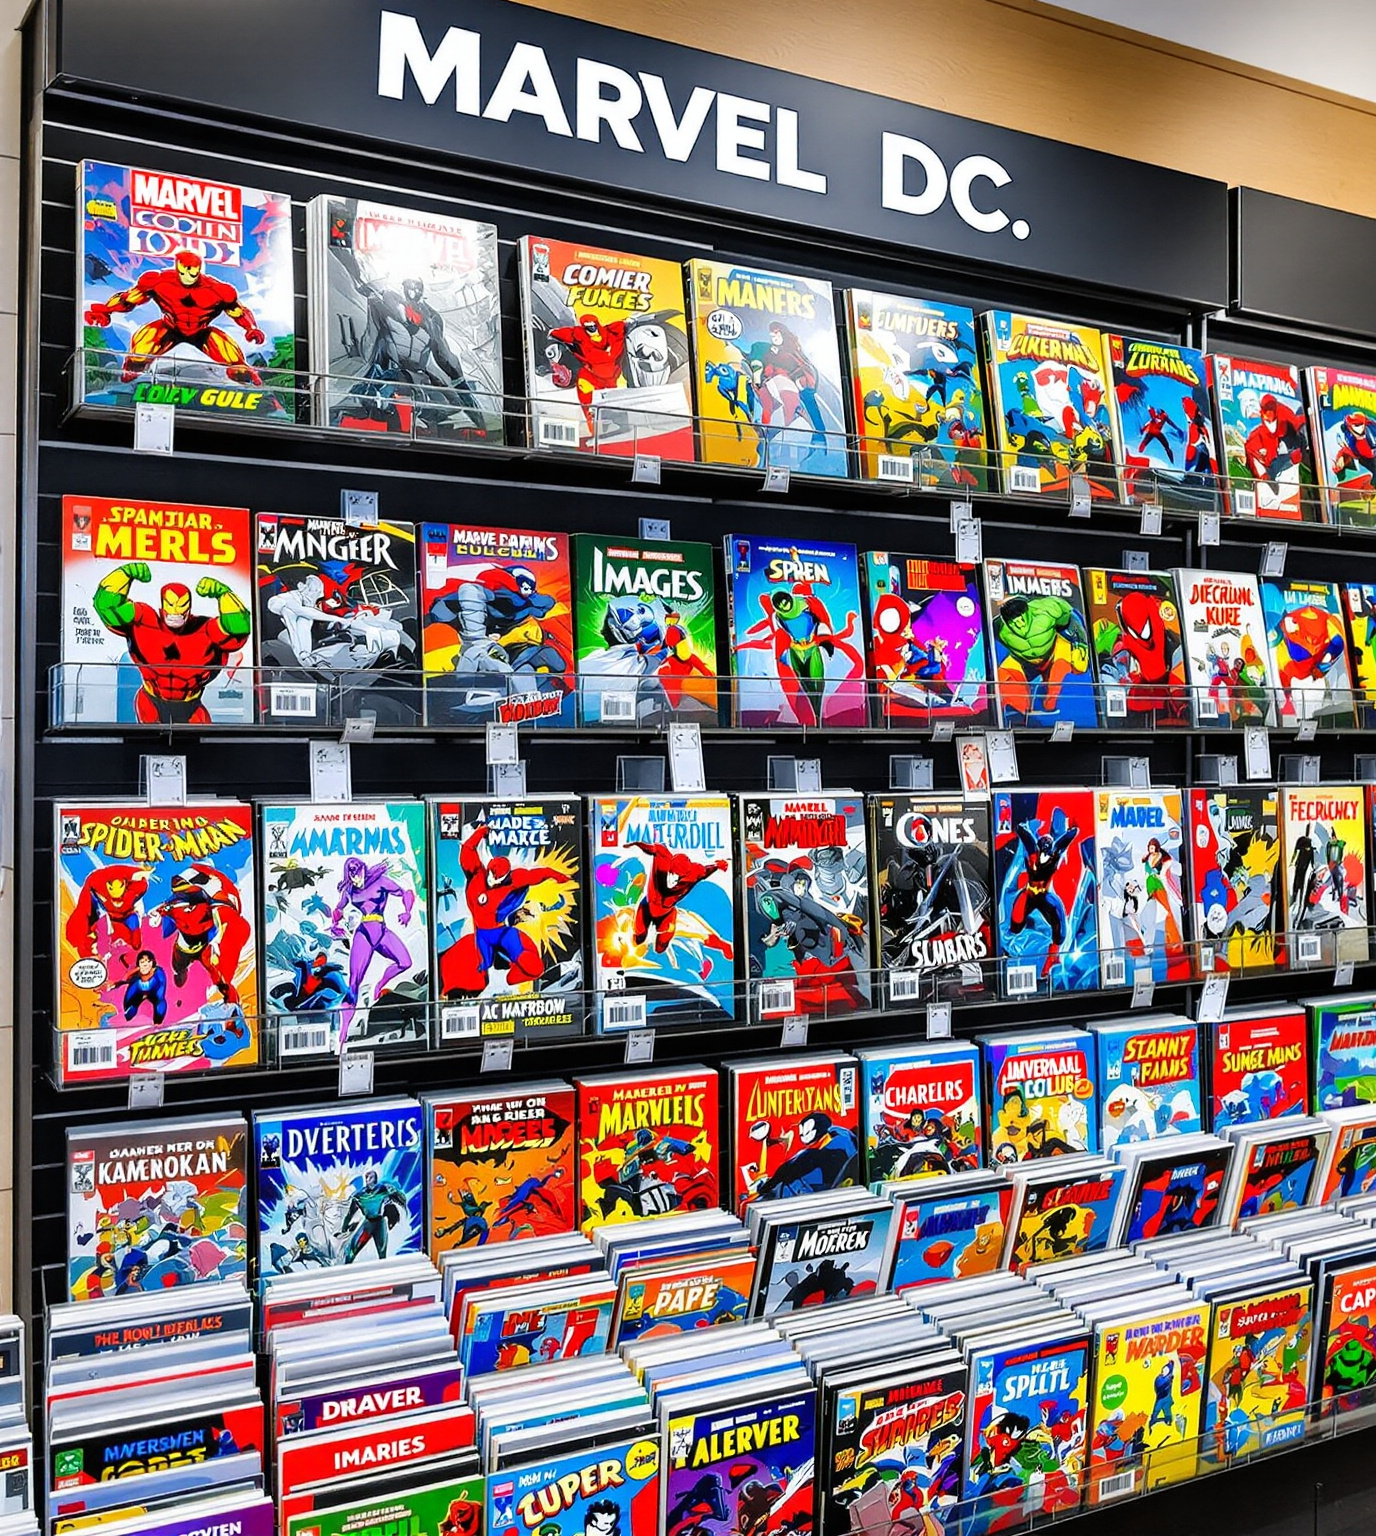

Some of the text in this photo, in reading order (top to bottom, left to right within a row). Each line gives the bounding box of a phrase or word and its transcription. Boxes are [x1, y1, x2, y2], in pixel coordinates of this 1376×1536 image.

[377, 9, 1031, 240] MARVEL DC.
[134, 173, 239, 221] MARVEL
[200, 388, 263, 411] GULE
[95, 523, 236, 564] MERLS
[593, 546, 705, 600] IMAGES
[654, 1283, 719, 1316] PAPE
[322, 1386, 424, 1421] DRAVER
[334, 1435, 426, 1470] IMARIES
